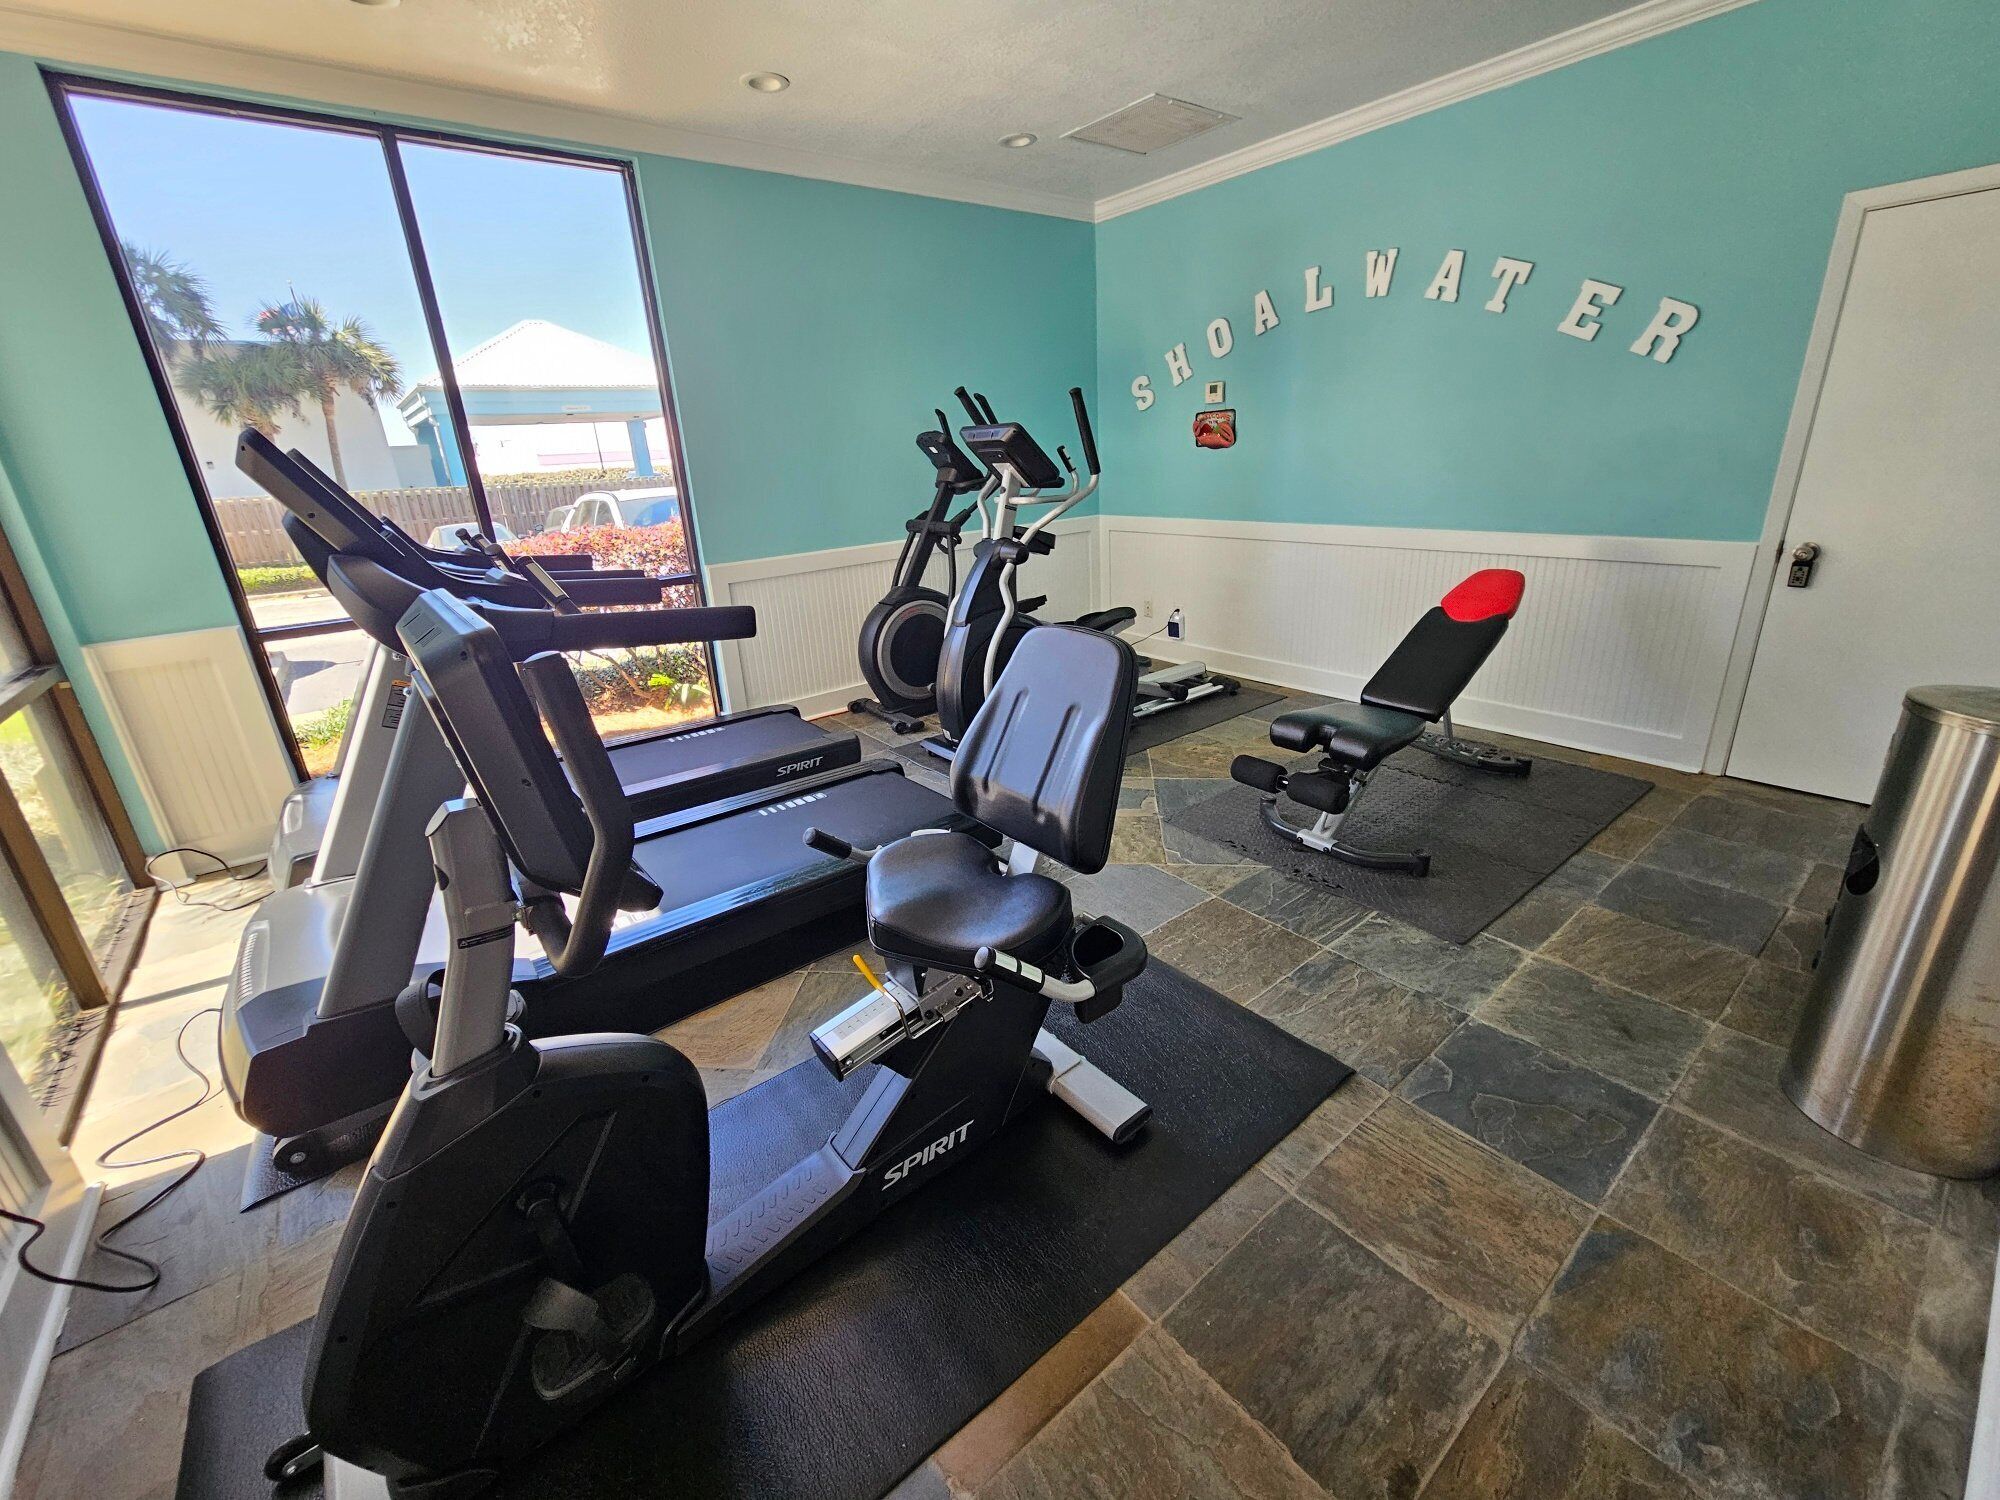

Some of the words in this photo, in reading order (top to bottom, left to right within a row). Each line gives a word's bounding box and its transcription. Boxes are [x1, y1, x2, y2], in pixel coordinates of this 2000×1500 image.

[1131, 247, 1699, 411] SHOALWATER
[776, 756, 823, 777] SPIRIT
[882, 1119, 975, 1191] SPIRIT
